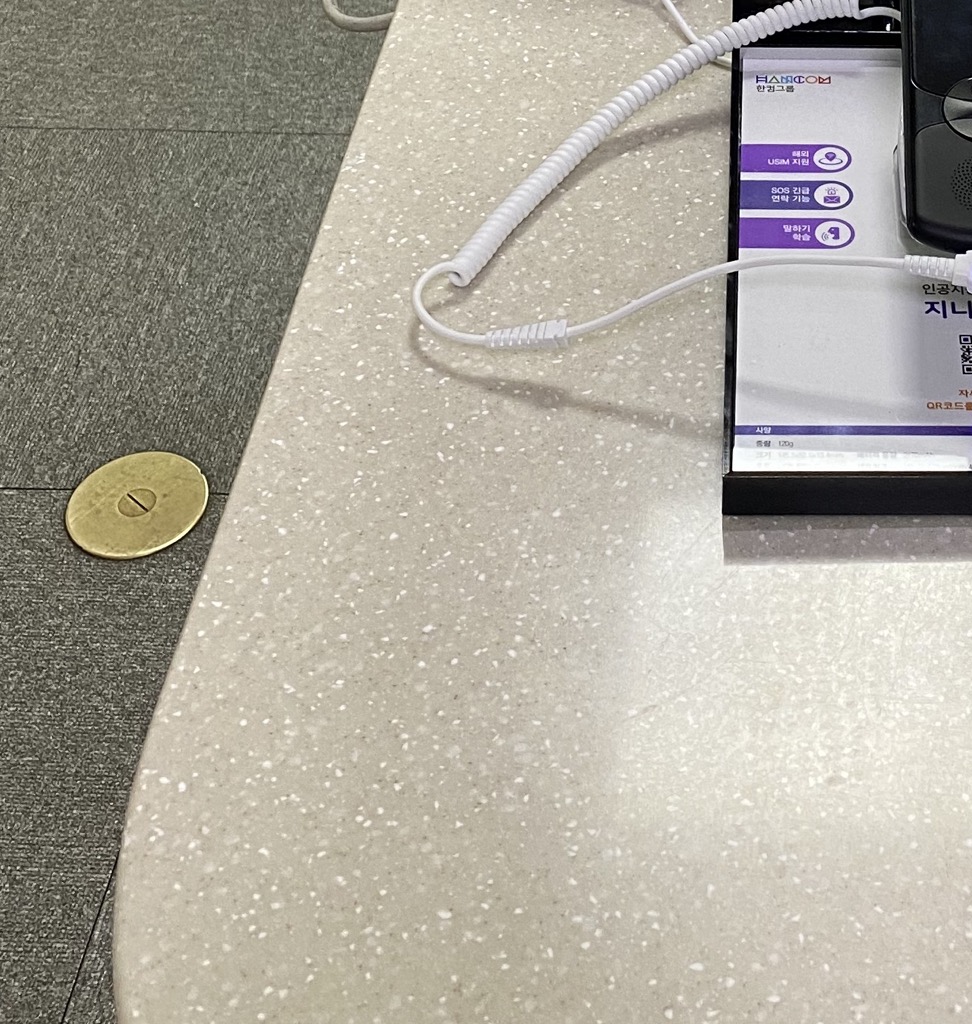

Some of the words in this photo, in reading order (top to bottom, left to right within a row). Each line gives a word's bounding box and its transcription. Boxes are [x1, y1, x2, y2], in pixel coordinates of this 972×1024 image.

[756, 85, 795, 93] 한컴그룹
[791, 158, 810, 166] 지원
[771, 186, 790, 194] SOS
[792, 186, 810, 195] 긴급
[771, 195, 790, 203] 연락
[782, 224, 811, 233] 말하기
[922, 283, 972, 296] 인공지
